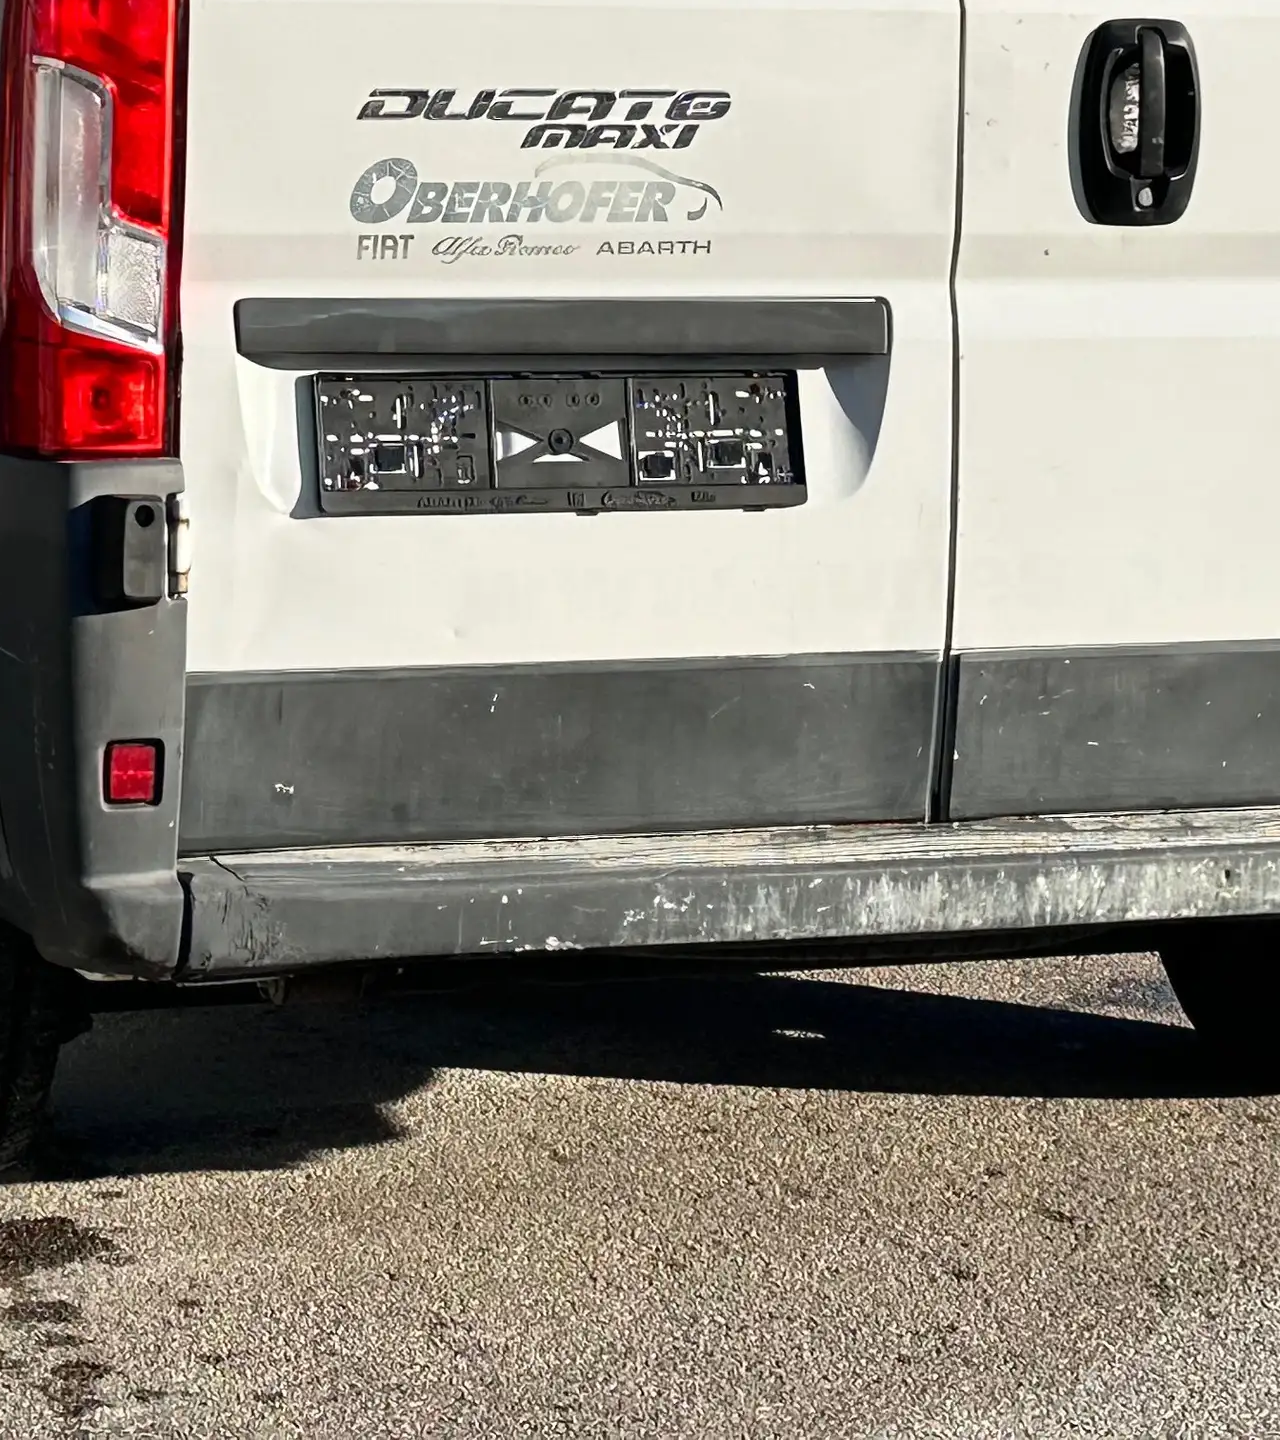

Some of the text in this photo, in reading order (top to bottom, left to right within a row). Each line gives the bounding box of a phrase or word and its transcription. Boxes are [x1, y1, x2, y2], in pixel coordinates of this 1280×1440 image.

[356, 88, 731, 121] DUCATO
[520, 123, 700, 149] MAXI
[350, 157, 677, 224] OBERHOFER
[356, 234, 712, 264] FIAT Alfa Romeo ABARTH
